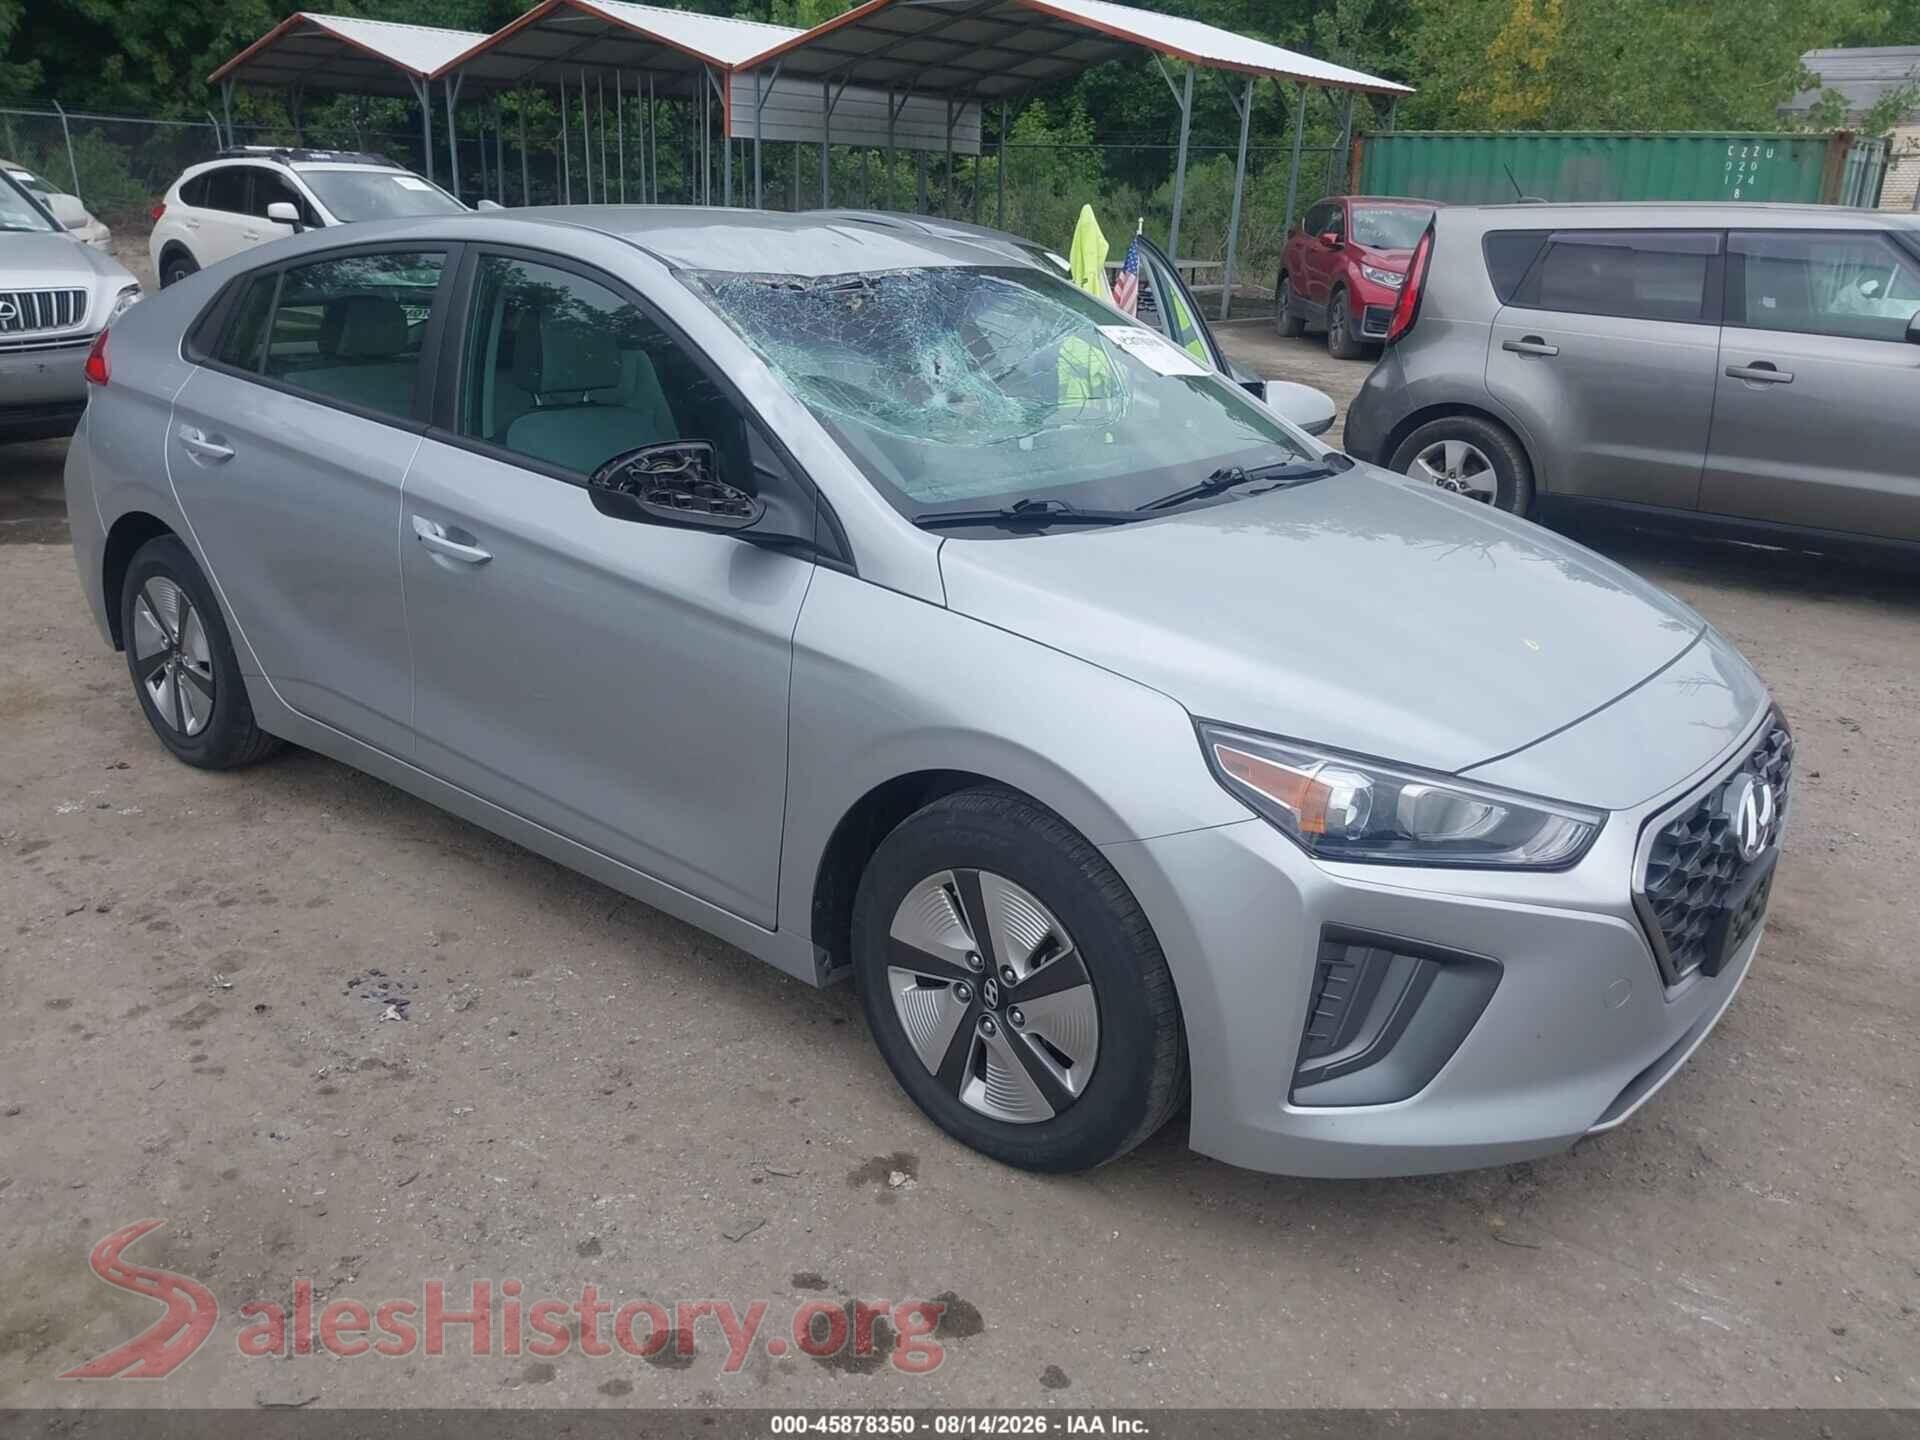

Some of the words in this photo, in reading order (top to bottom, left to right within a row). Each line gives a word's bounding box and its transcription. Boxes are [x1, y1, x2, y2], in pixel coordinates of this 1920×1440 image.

[1727, 145, 1774, 159] CZZU
[1725, 161, 1758, 171] 020
[1724, 174, 1755, 185] 174
[1733, 188, 1741, 199] 8
